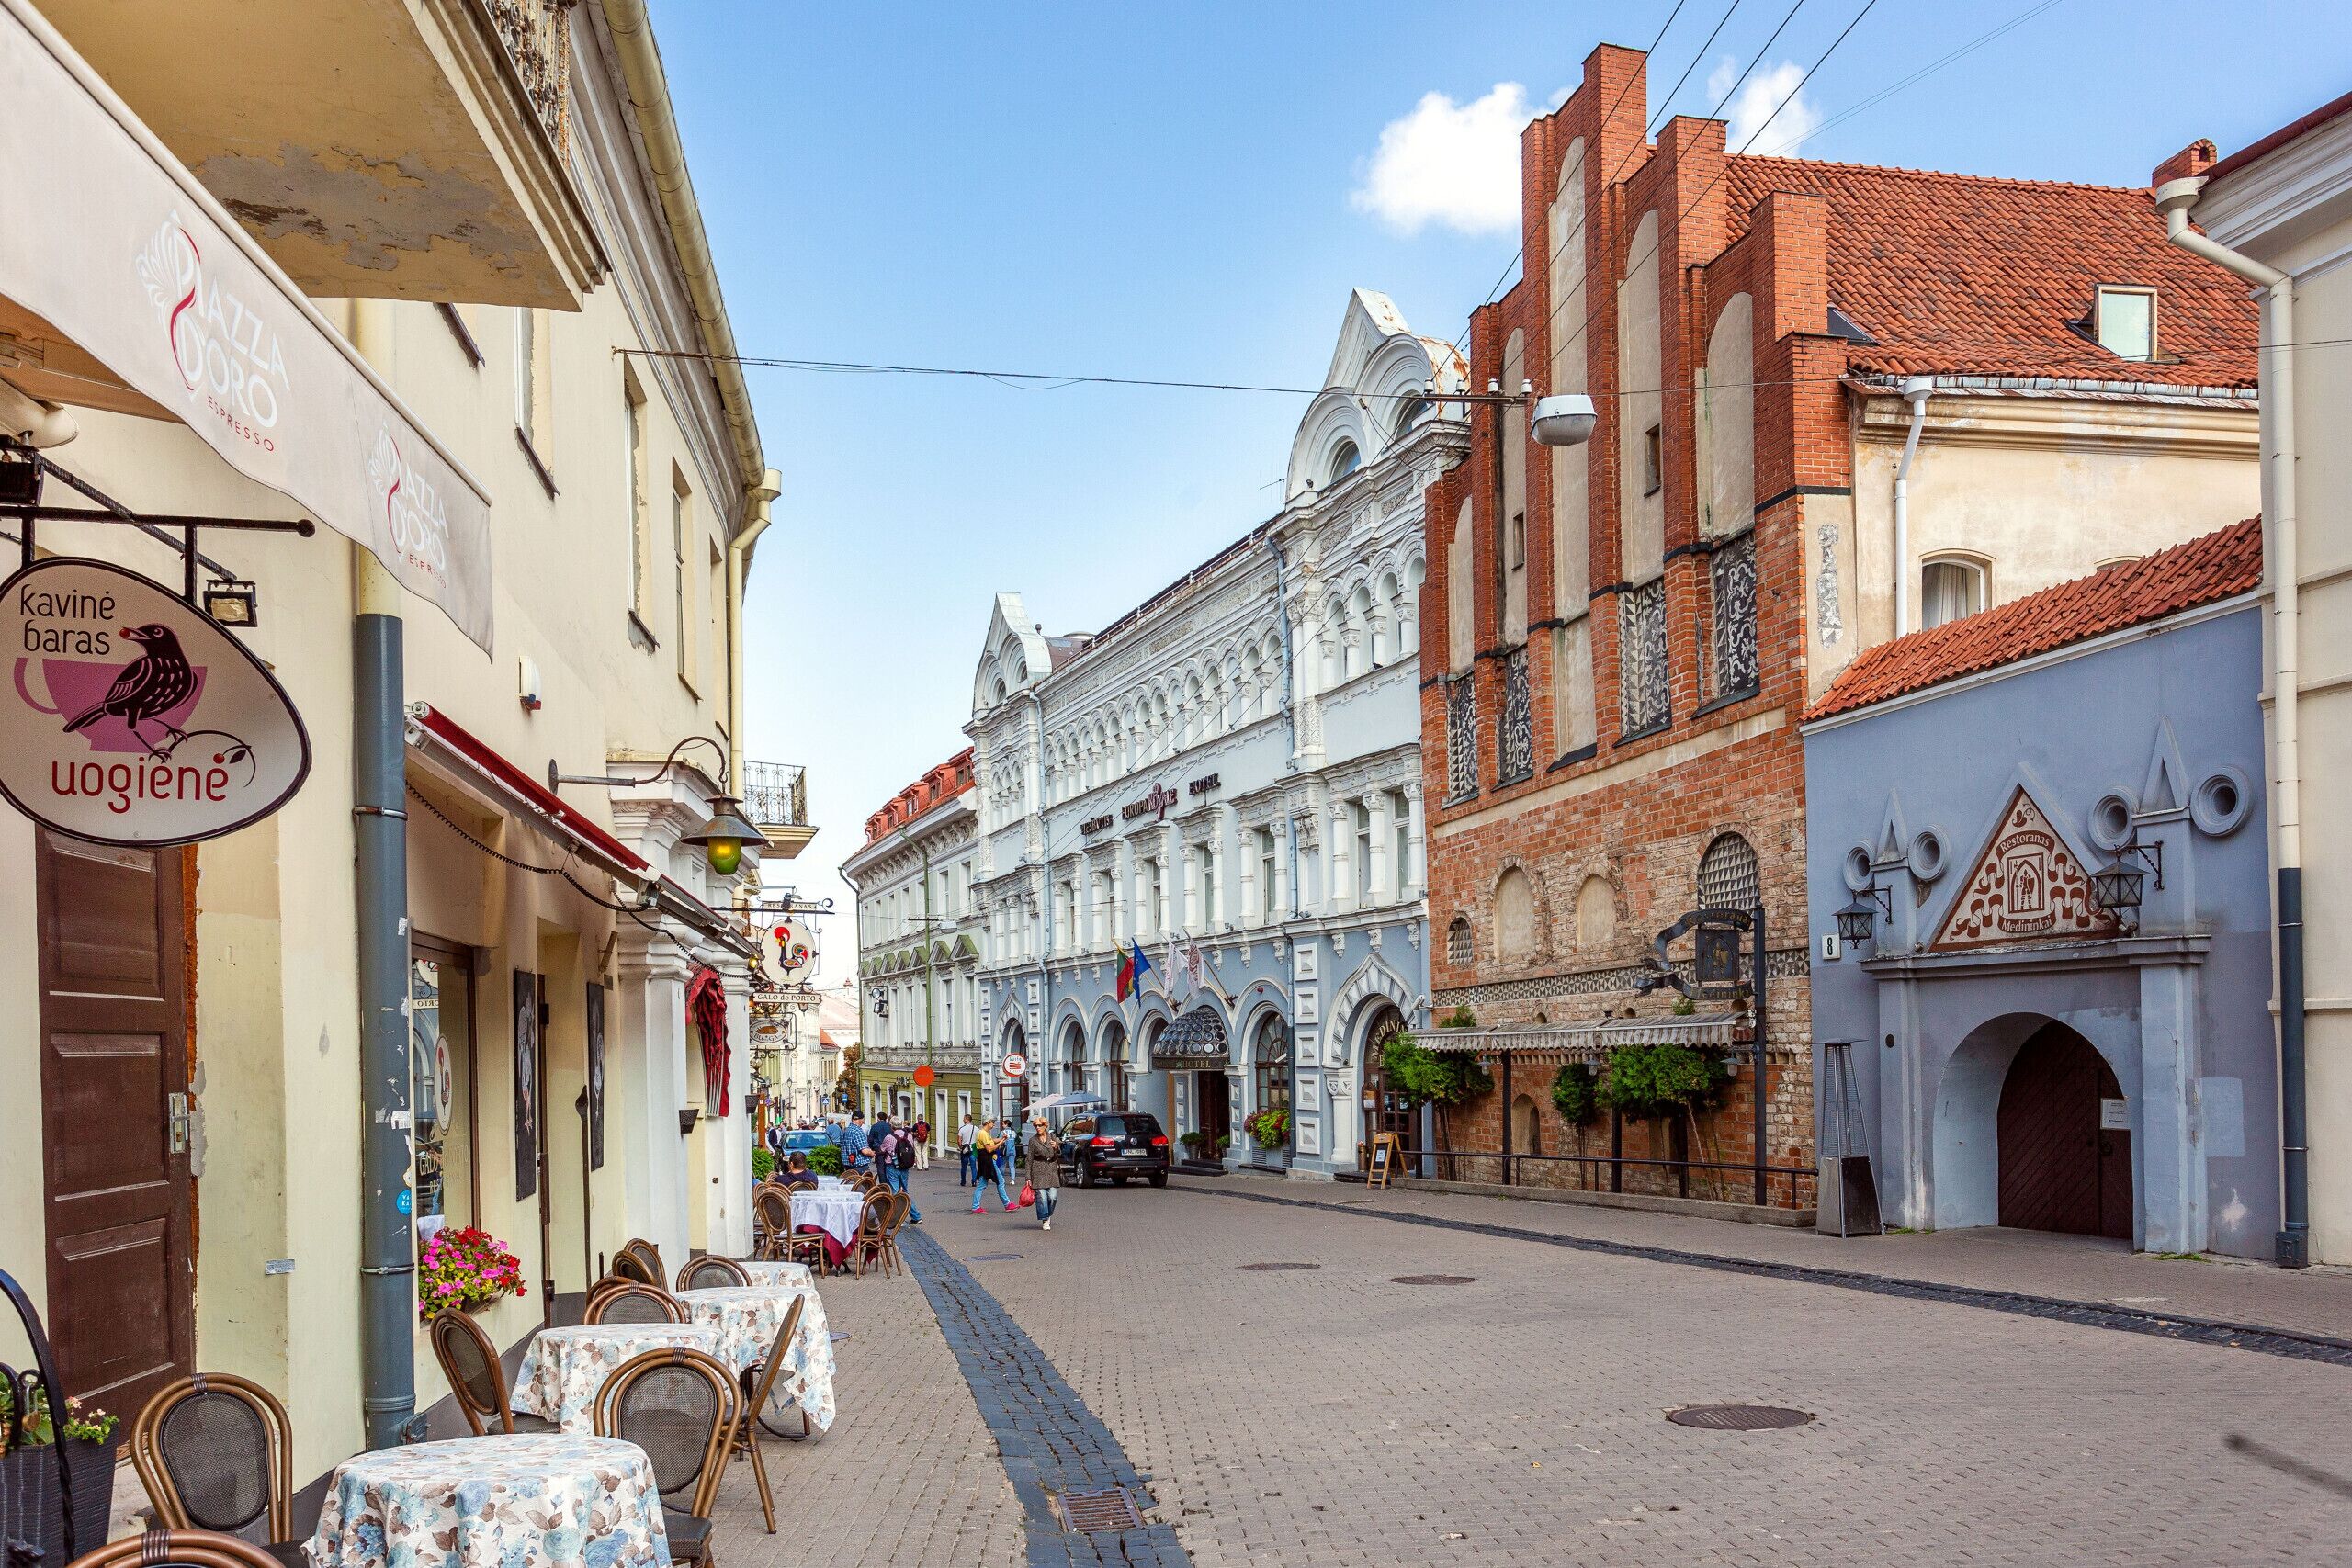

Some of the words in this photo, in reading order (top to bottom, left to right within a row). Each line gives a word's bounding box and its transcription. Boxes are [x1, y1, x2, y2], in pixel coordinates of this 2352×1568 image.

[208, 394, 275, 454] ESPRESSO
[19, 583, 116, 620] kavinė
[24, 620, 110, 655] baras
[51, 754, 230, 814] uogienė
[2000, 834, 2051, 853] Restoranas
[2001, 915, 2052, 932] Medininkai
[1827, 937, 1833, 955] 8
[1182, 1059, 1211, 1068] HOTEL
